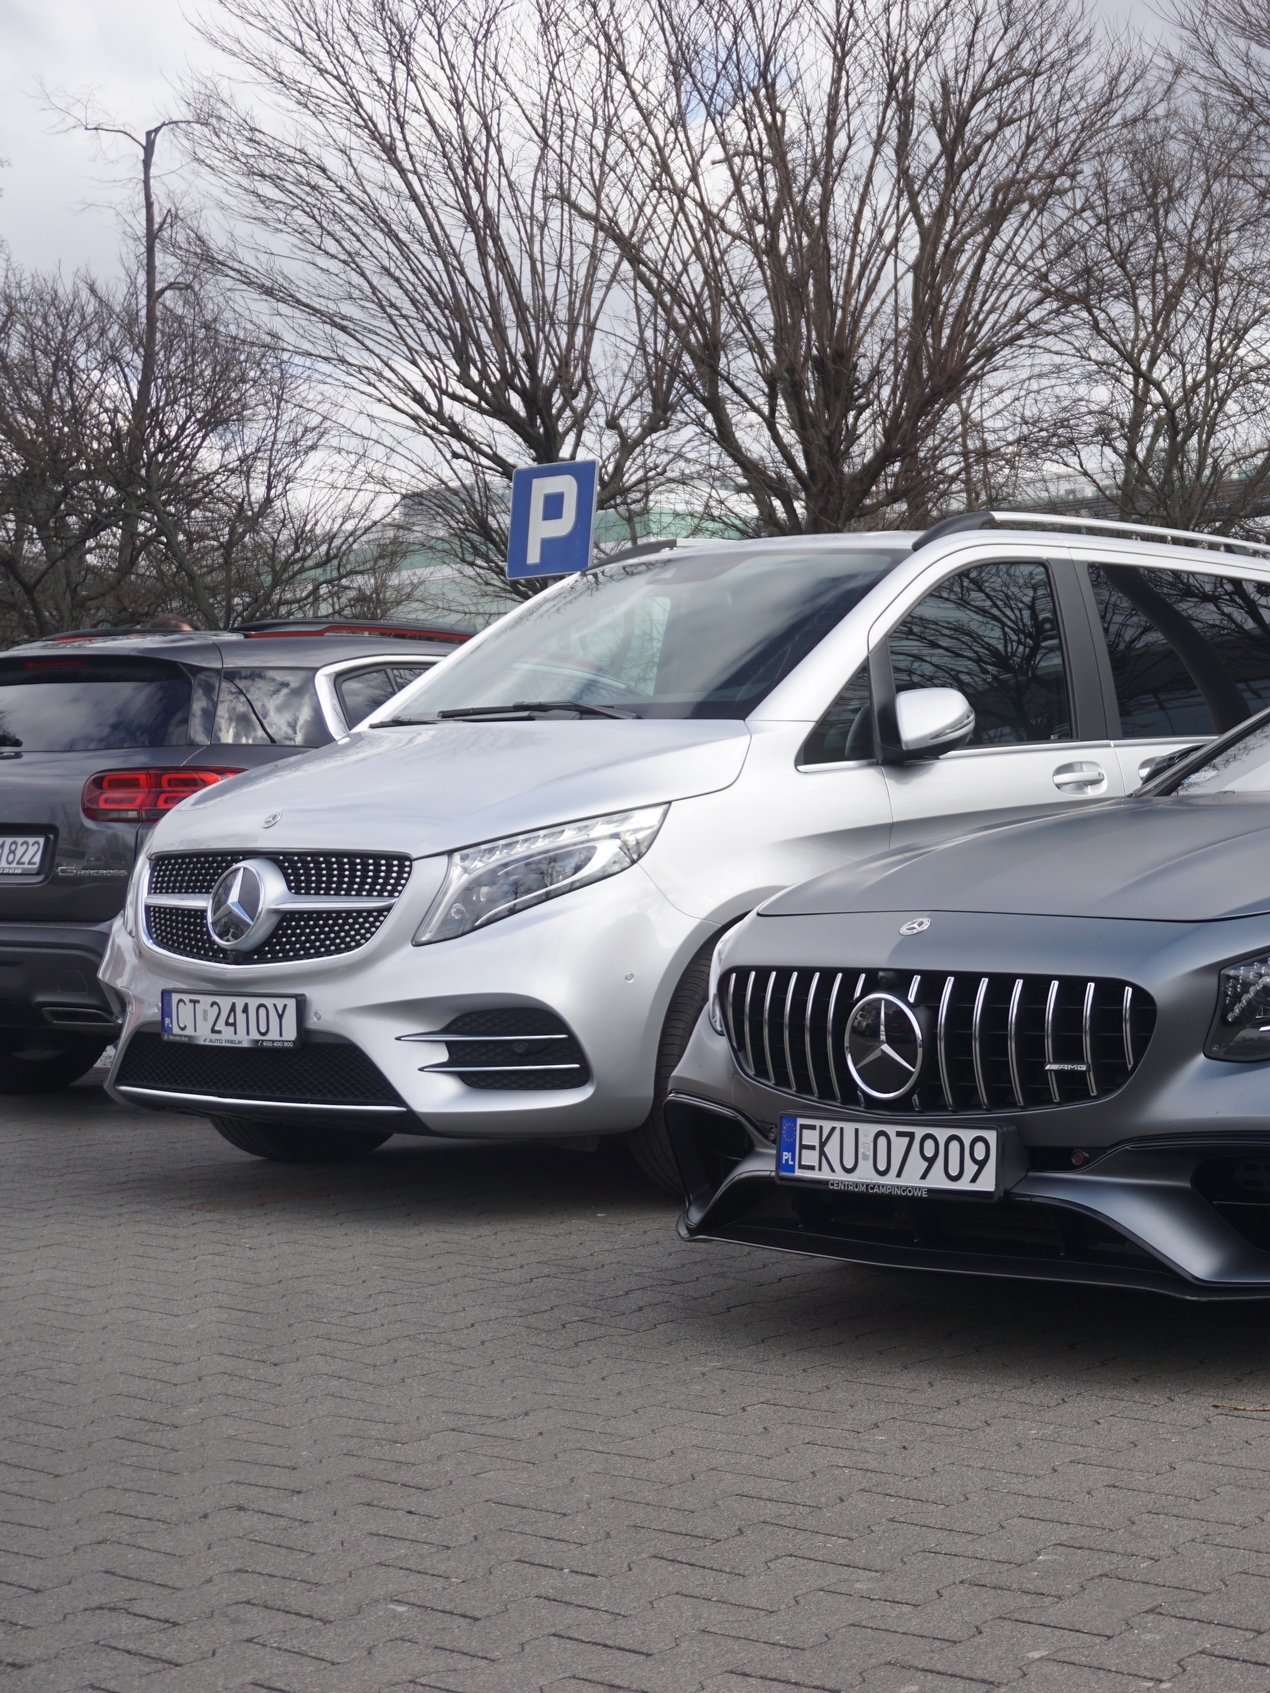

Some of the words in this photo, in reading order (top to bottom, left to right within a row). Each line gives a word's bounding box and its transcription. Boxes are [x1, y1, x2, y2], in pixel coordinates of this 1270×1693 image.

[527, 475, 578, 564] P
[165, 1017, 172, 1027] PL
[176, 998, 200, 1032] CT
[210, 1000, 288, 1038] 2410Y
[782, 1151, 794, 1165] PL
[797, 1123, 859, 1174] EKU
[872, 1129, 991, 1183] 07909
[828, 1180, 866, 1193] CENTRUM
[868, 1183, 928, 1198] CAMPINGOWE
